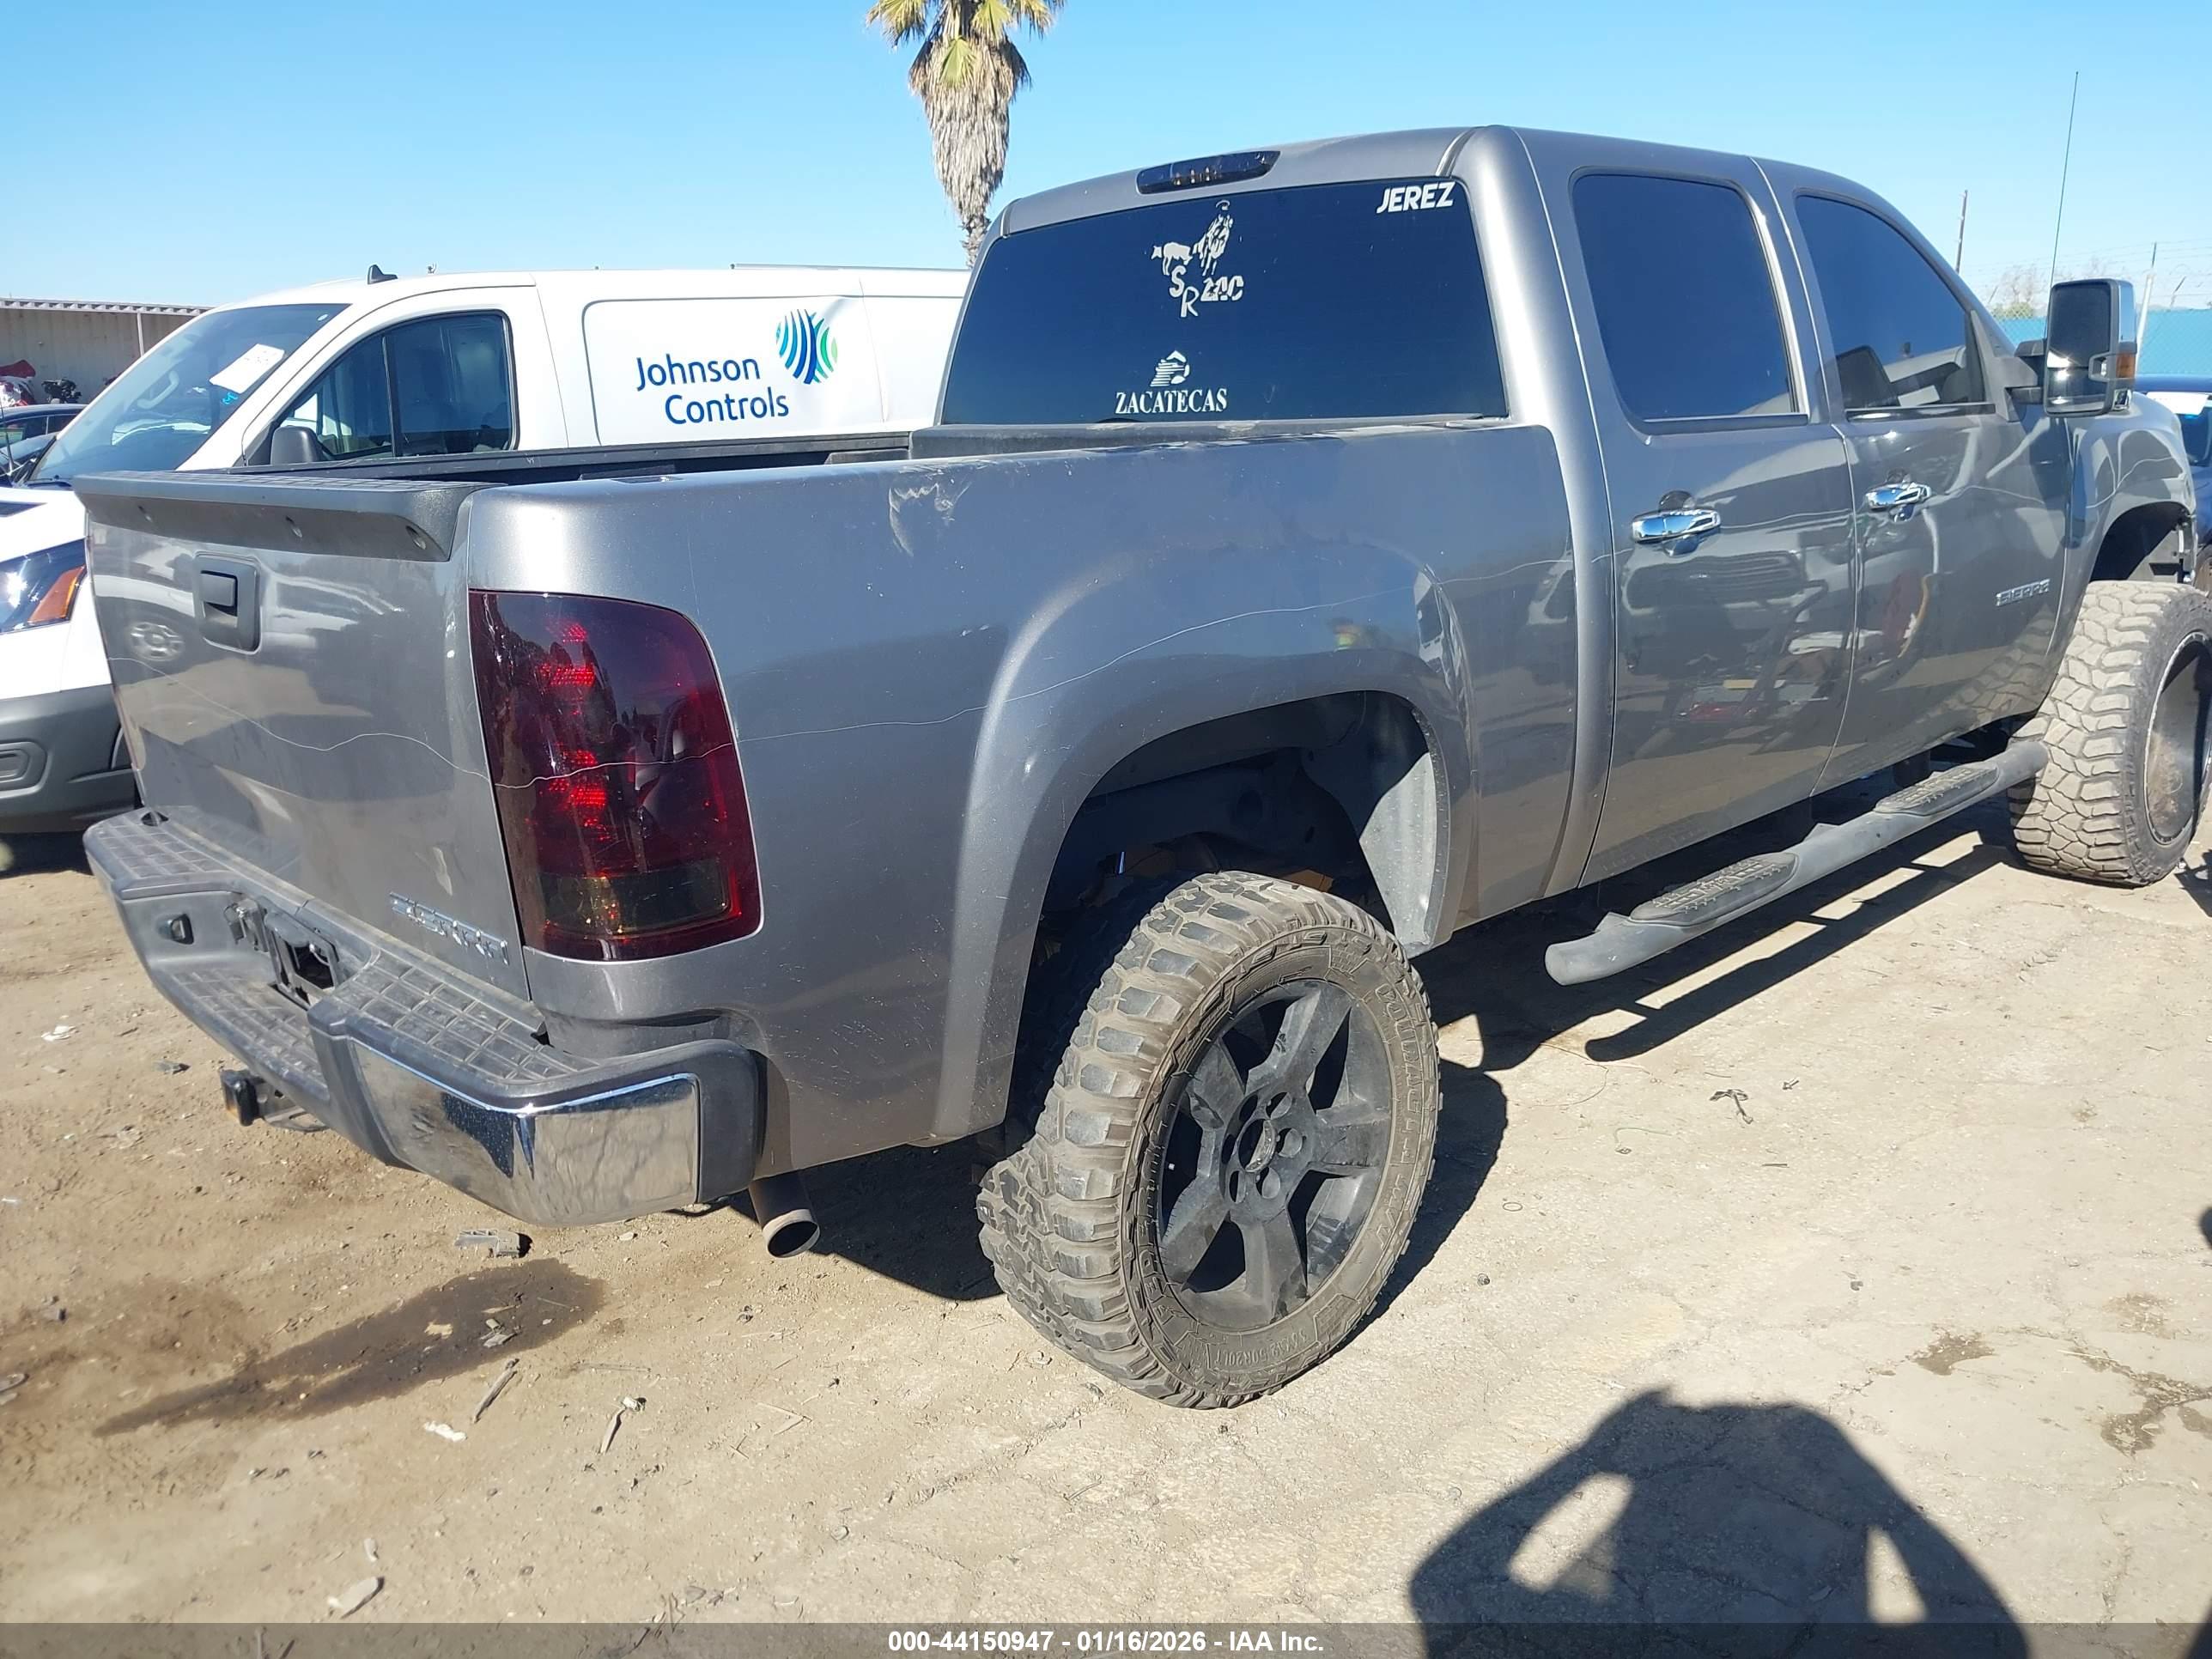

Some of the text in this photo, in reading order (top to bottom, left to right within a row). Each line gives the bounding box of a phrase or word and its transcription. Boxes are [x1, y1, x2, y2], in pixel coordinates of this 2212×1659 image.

[1376, 179, 1456, 214] JEREZ
[635, 353, 761, 392] Johnson
[665, 386, 790, 426] Controls
[1114, 386, 1230, 416] ZACATECAS
